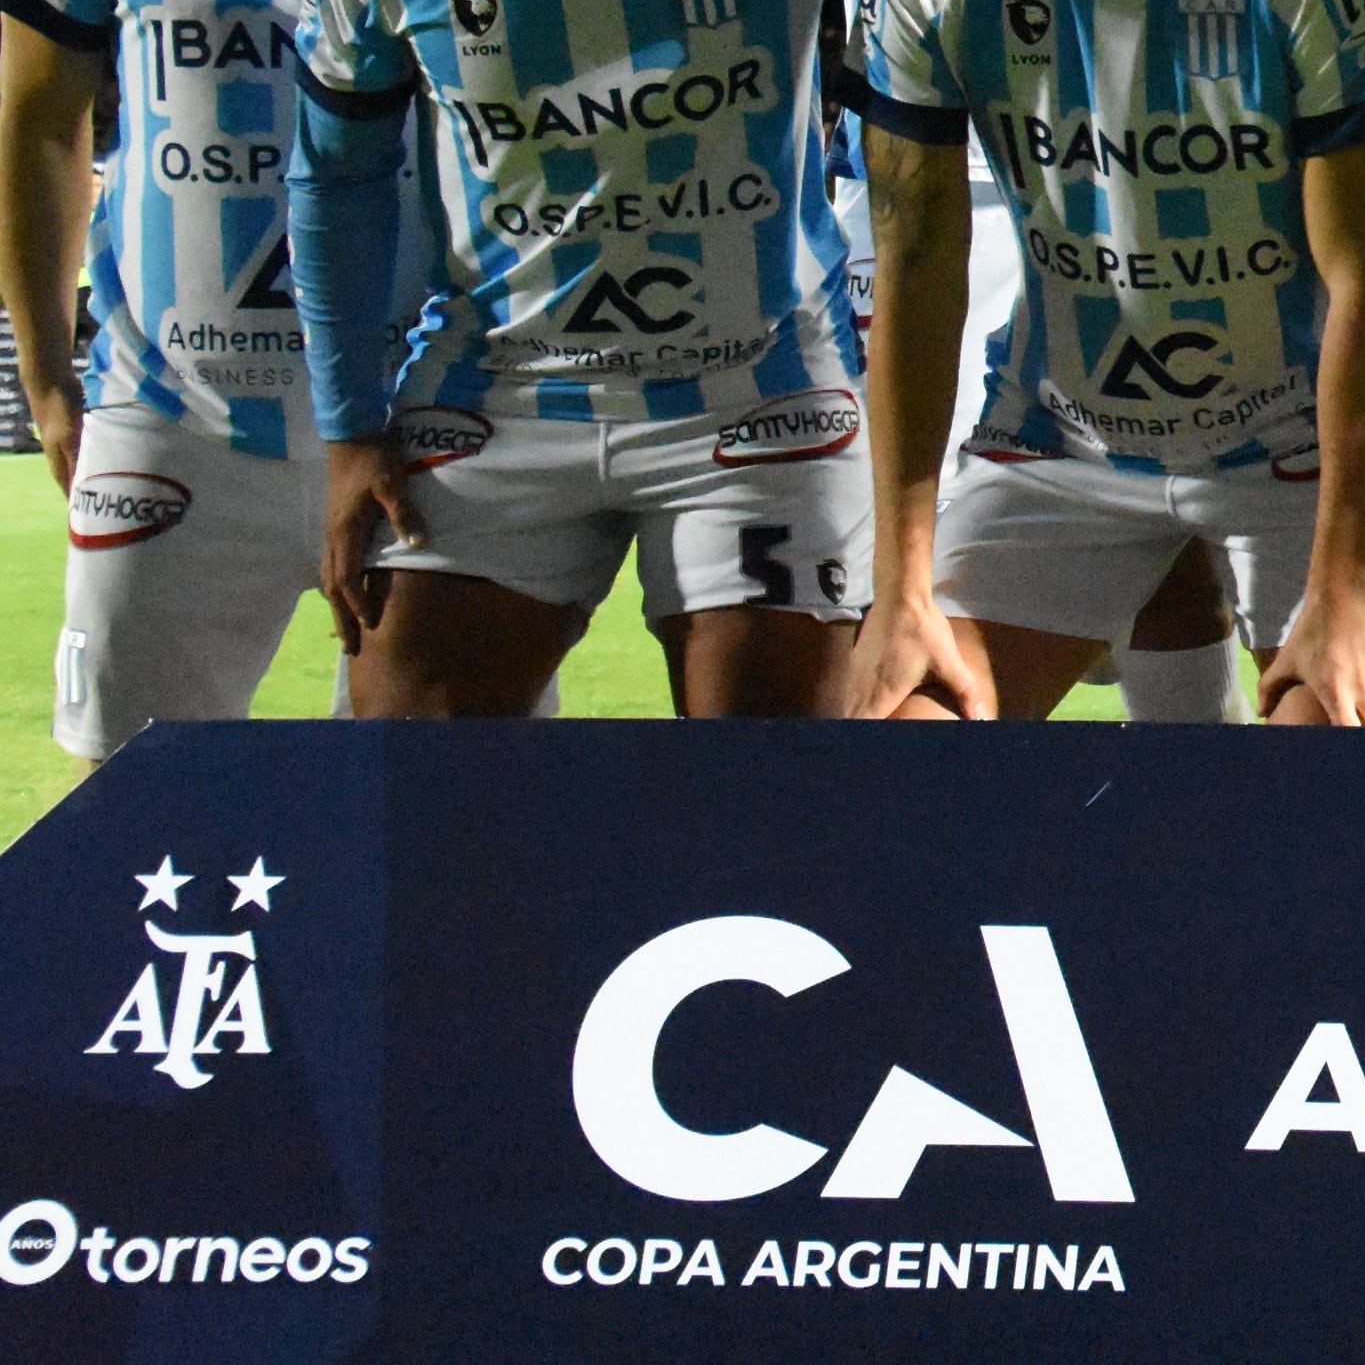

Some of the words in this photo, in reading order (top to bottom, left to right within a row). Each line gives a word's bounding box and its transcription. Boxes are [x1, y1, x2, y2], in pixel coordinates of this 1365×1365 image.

[462, 44, 503, 58] LYON
[1010, 53, 1052, 66] LYON
[476, 58, 763, 143] BANCOR
[1024, 115, 1276, 179] BANCOR
[562, 265, 698, 334] AC
[1099, 331, 1225, 400] AC
[1050, 392, 1182, 437] Adhemar
[1191, 374, 1298, 432] Capital
[738, 523, 794, 606] 5
[79, 1226, 374, 1284] torneos
[540, 1236, 729, 1289] COPA
[740, 1238, 1127, 1294] ARGENTINA
